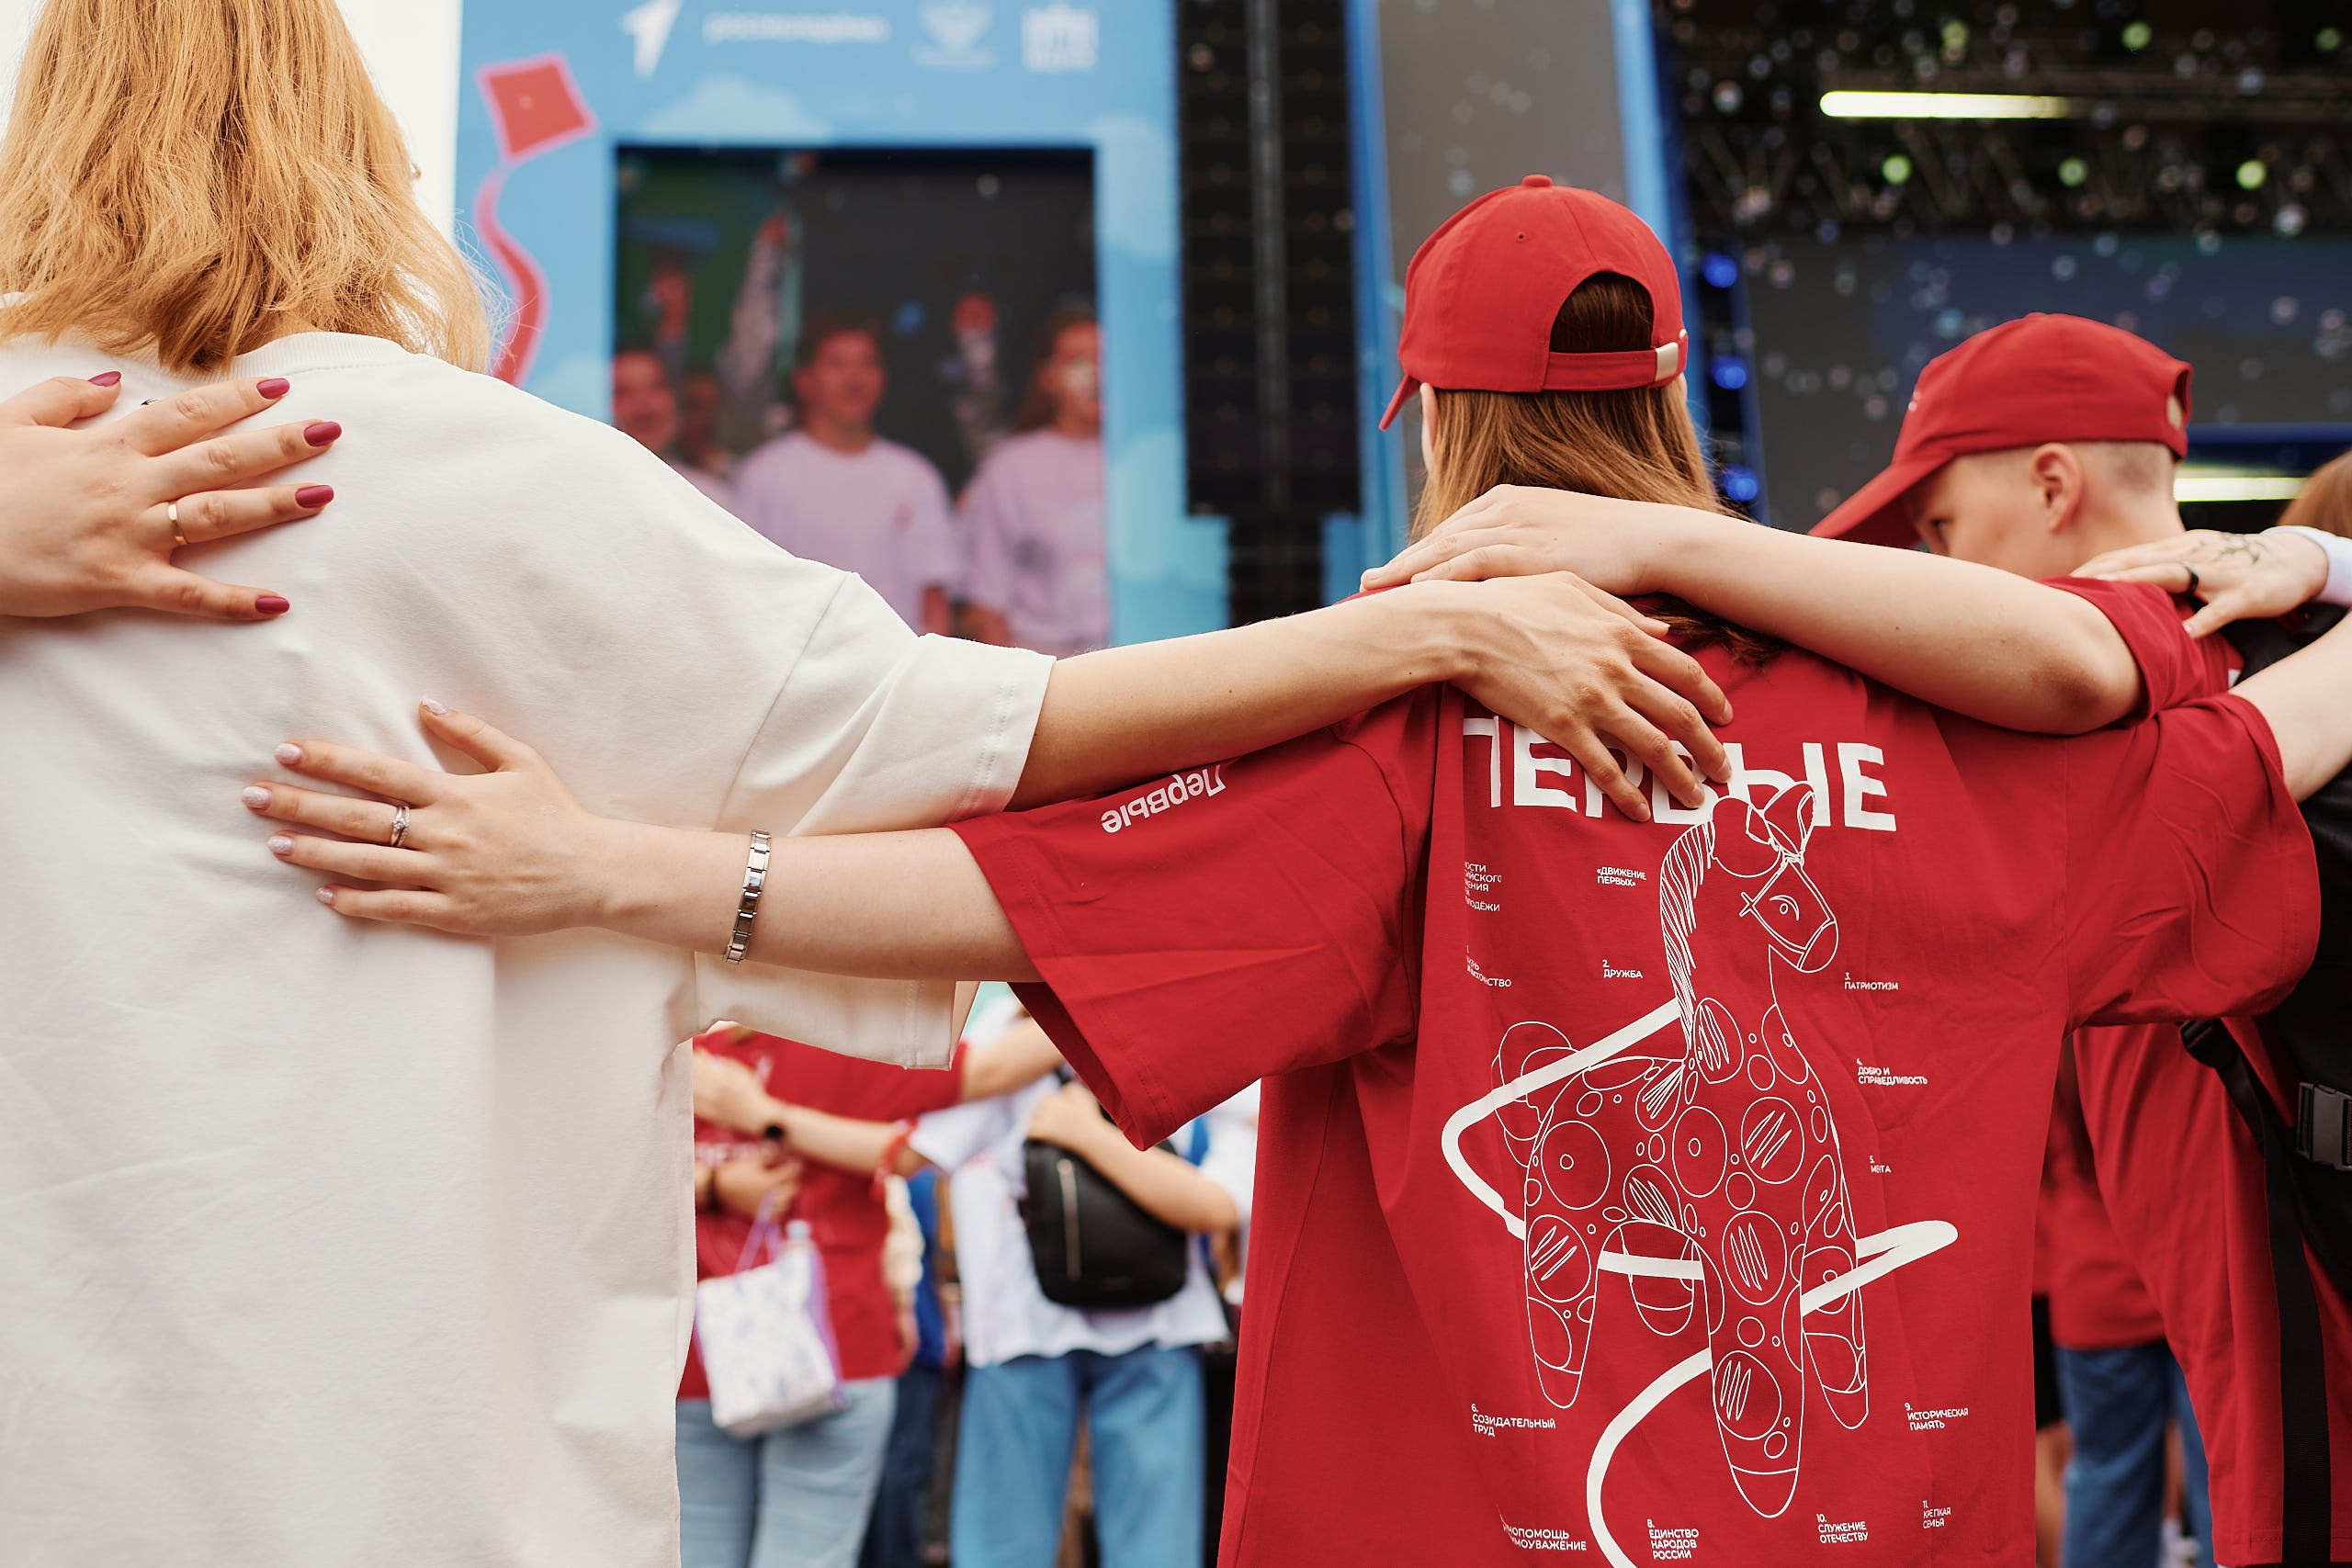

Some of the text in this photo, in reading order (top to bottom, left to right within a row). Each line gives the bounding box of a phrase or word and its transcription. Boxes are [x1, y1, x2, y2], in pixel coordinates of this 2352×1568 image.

[1102, 764, 1227, 834] Первые
[1597, 866, 1647, 881] «ДВИЖЕНИЕ
[1603, 968, 1644, 979] ДРУЖБА
[1844, 981, 1899, 991] ПАТРИОТИЗМ
[1471, 1403, 1479, 1413] 6.
[1904, 1402, 1913, 1412] 9.
[1906, 1407, 1969, 1421] ИСТОРИЧЕСКАЯ
[1472, 1413, 1556, 1429] СОЗИДАТЕЛЬНЫЙ
[1909, 1419, 1946, 1431] ПАМЯТЬ
[1473, 1423, 1496, 1438] ТРУД
[1646, 1518, 1656, 1529] 8.
[1815, 1513, 1827, 1523] 10.
[1817, 1520, 1867, 1533] СЛУЖЕНИЕ
[1648, 1528, 1700, 1540] ЕДИНСТВО
[1819, 1531, 1869, 1544] ОТЕЧЕСТВУ
[1650, 1539, 1698, 1551] НАРОДОВ
[1652, 1550, 1692, 1561] РОССИИ
